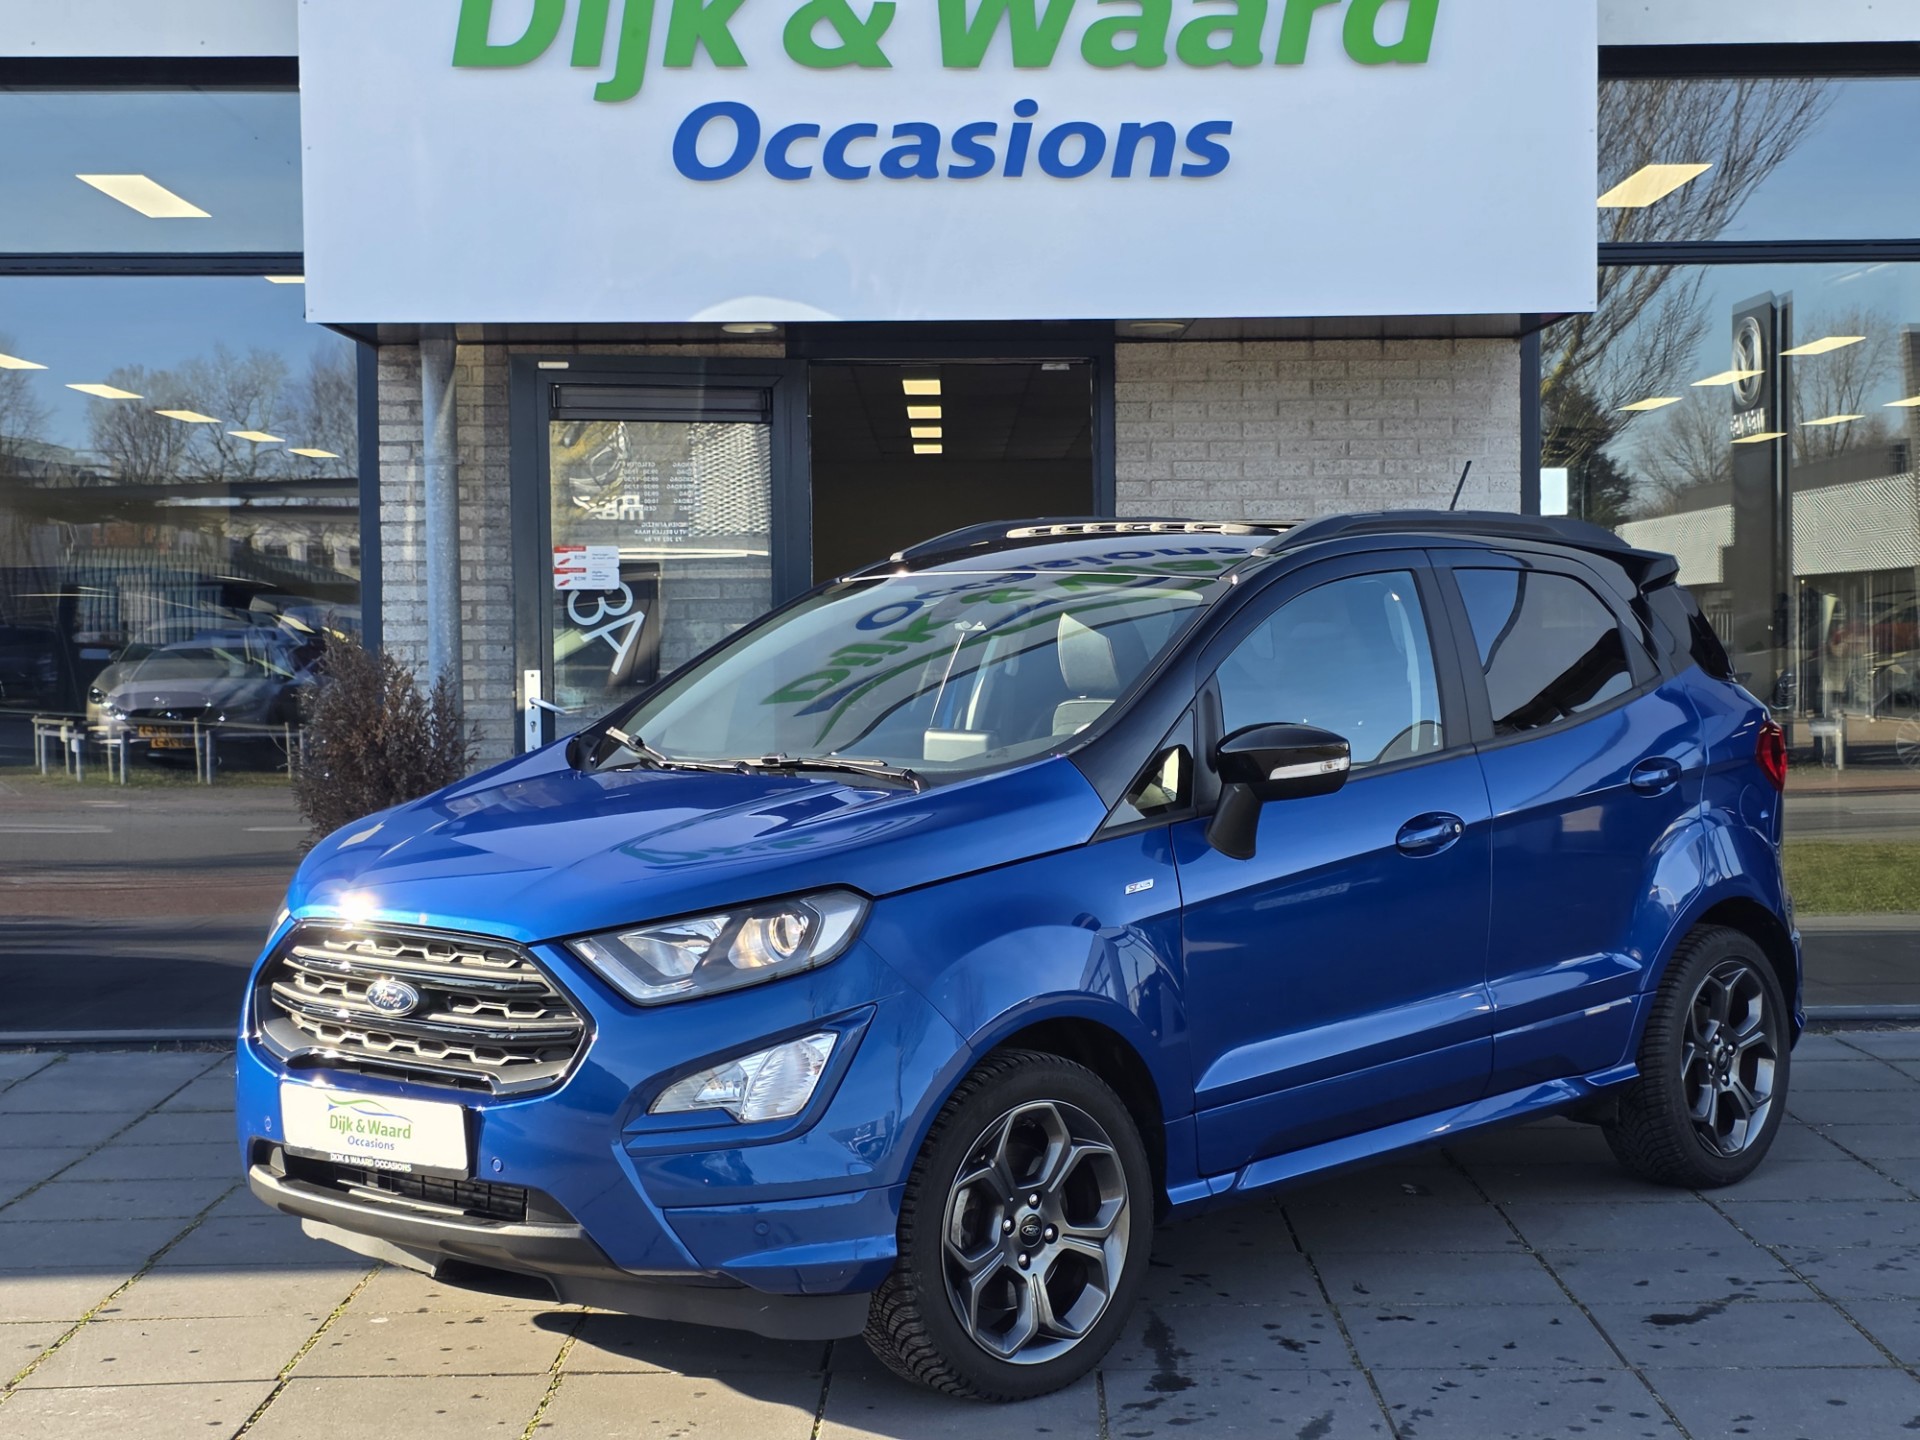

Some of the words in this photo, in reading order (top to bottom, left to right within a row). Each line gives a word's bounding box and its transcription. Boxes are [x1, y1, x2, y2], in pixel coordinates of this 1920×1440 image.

[451, 0, 748, 103] Dijk
[782, 0, 897, 70] &
[935, 0, 1440, 70] Waard
[671, 98, 1233, 182] Occasions
[329, 1114, 353, 1135] Dijk
[356, 1119, 365, 1133] &
[367, 1119, 411, 1139] Waard
[347, 1135, 395, 1150] Occasions
[330, 1153, 345, 1163] DIJK
[350, 1155, 374, 1167] WAARD
[374, 1159, 412, 1173] OCCASIONS
